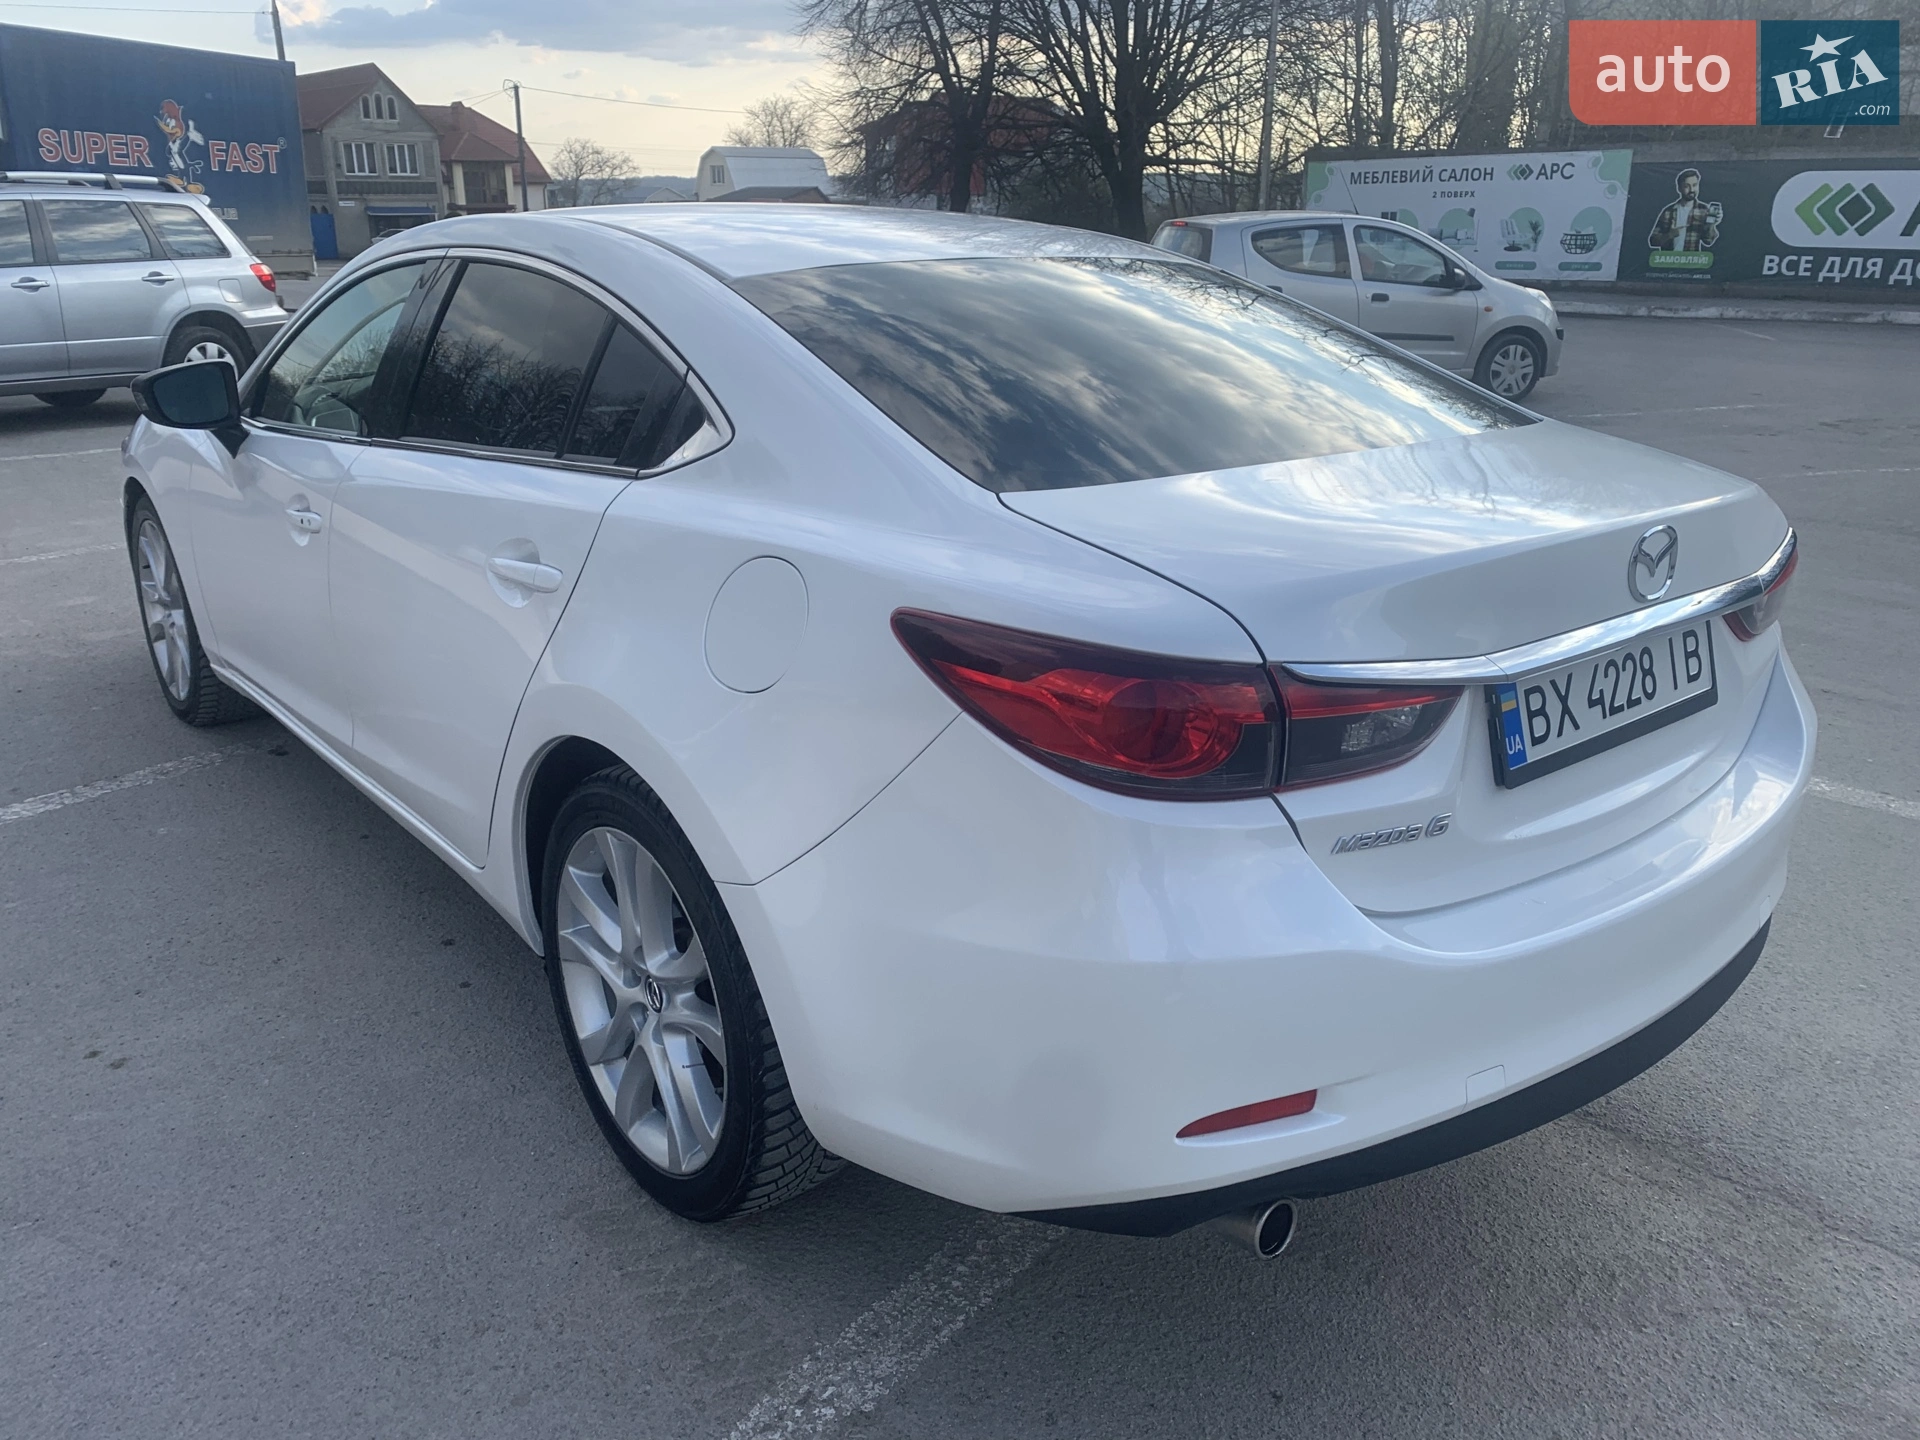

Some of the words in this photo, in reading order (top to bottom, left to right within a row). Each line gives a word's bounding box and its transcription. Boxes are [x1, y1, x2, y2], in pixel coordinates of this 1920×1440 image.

[38, 127, 154, 168] SUPER
[1350, 165, 1434, 185] МЕБЛЕВИЙ
[1438, 167, 1495, 183] САЛОН
[1440, 190, 1476, 198] ПОВЕРХ
[1762, 254, 1814, 277] ВСЕ
[1817, 256, 1884, 283] ДЛЯ
[1888, 258, 1920, 286] Д
[1523, 672, 1581, 747] BX
[1587, 646, 1658, 720] 4228
[1668, 629, 1703, 691] IB
[1505, 733, 1524, 755] UA
[1424, 812, 1453, 838] 6
